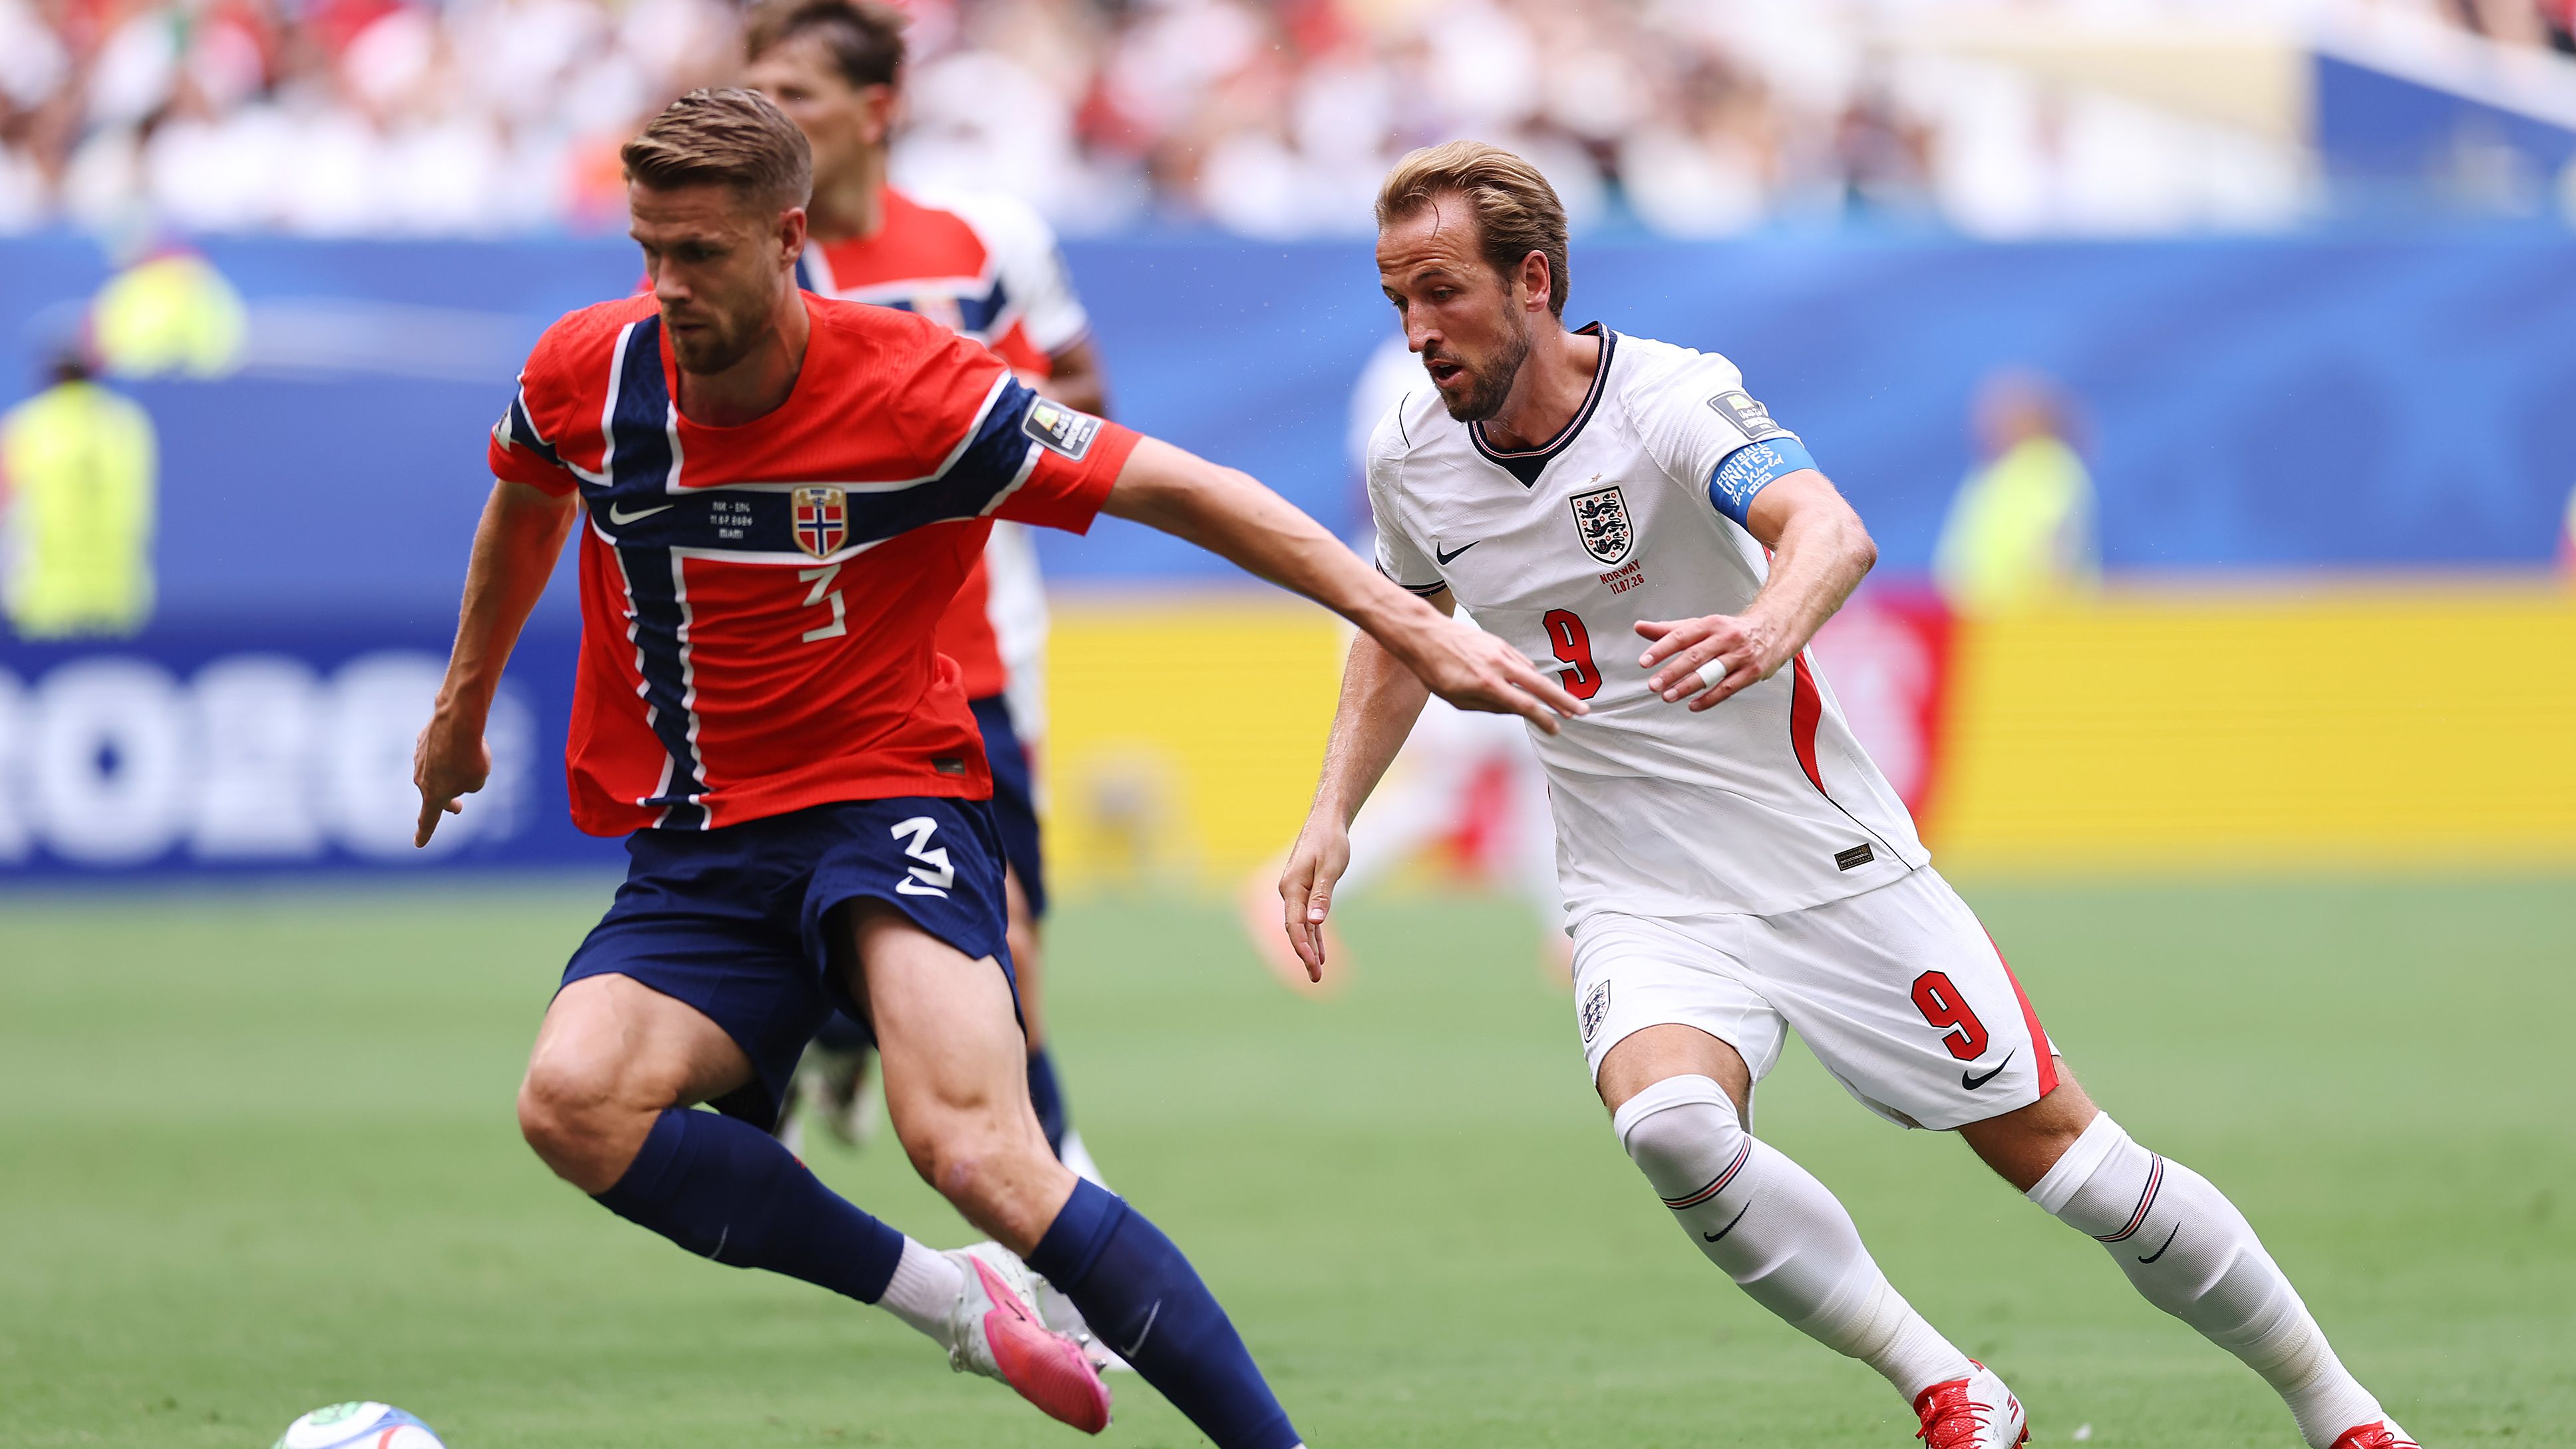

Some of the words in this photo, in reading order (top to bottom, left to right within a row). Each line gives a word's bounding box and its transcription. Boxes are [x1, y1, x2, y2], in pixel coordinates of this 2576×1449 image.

[1716, 442, 1767, 488] FOOTBALL
[1722, 447, 1774, 495] UNITES
[1732, 484, 1747, 506] the
[1744, 454, 1784, 484] World
[1599, 559, 1641, 584] NORWAY
[1610, 573, 1645, 595] 11.07.26
[798, 564, 847, 643] 3
[1542, 608, 1602, 700] 9
[890, 816, 955, 889] 3
[1911, 970, 1989, 1062] 9
